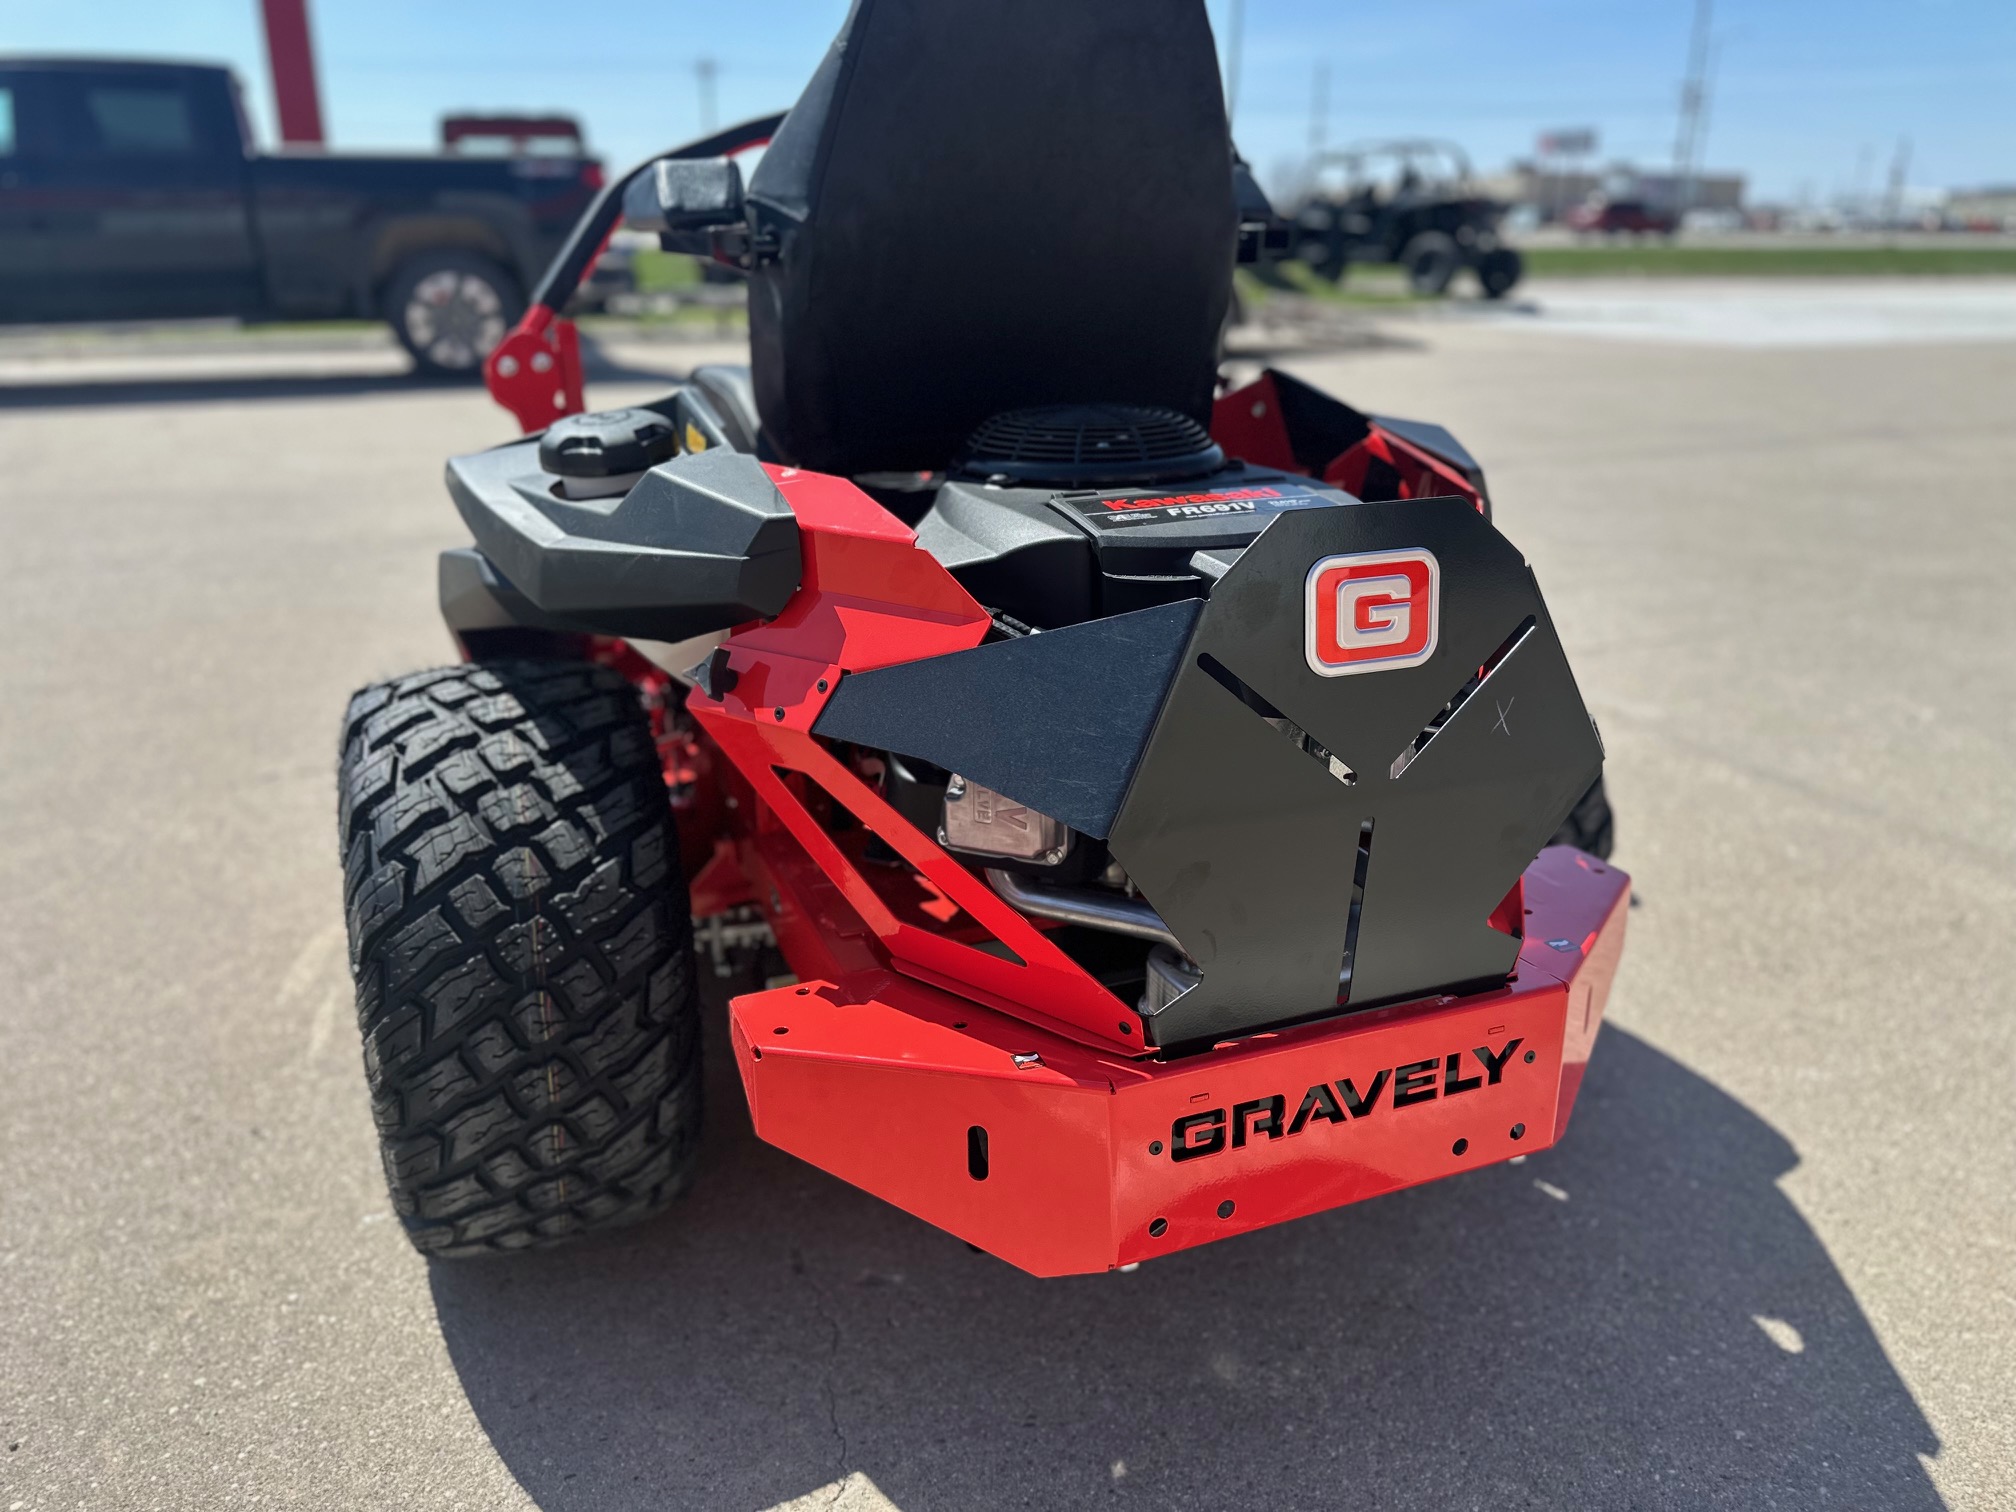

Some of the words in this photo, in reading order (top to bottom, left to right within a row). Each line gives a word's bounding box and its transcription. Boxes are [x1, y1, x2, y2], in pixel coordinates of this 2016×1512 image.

[1101, 486, 1283, 511] Kawasaki
[1167, 501, 1255, 517] FR691V
[1336, 573, 1411, 650] G
[1171, 1038, 1525, 1163] GRAVELY
